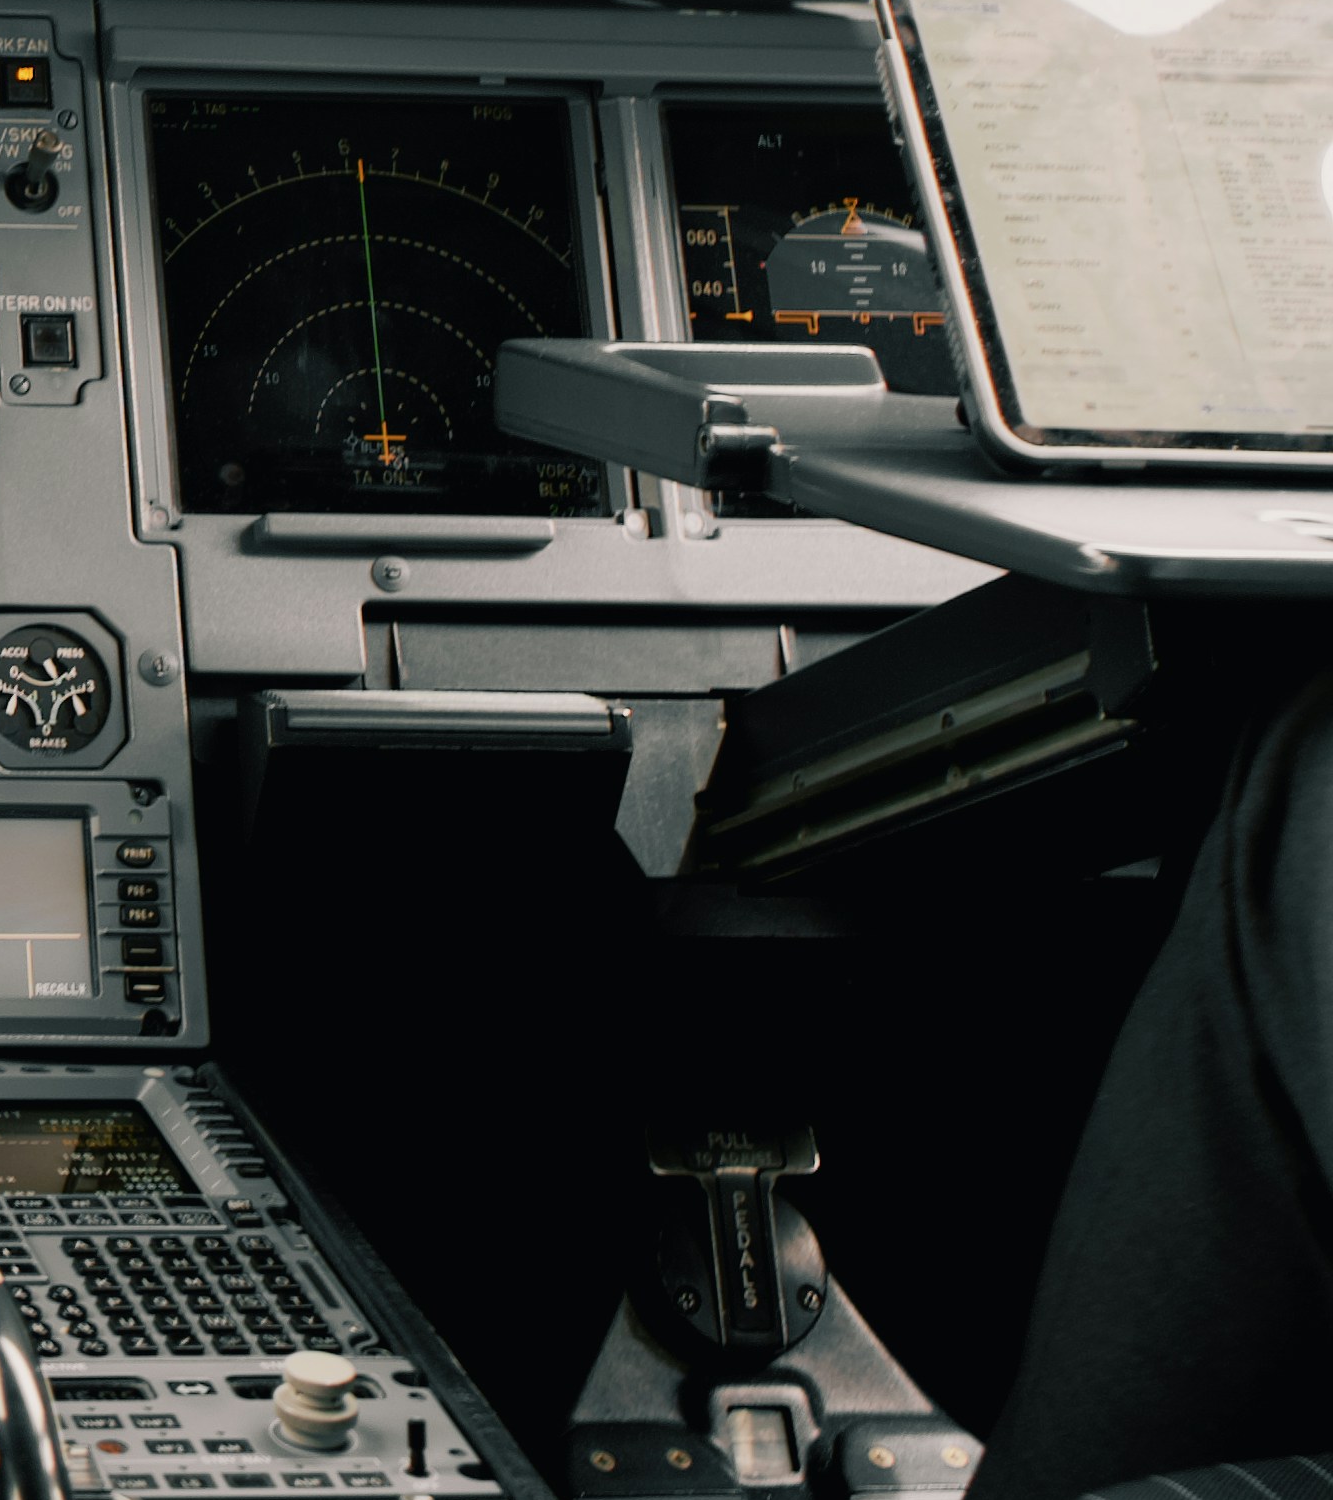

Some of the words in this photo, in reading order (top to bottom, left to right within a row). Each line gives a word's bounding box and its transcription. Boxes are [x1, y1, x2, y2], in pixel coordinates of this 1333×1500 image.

[18, 38, 48, 53] FAN
[58, 206, 81, 218] OFF
[44, 296, 67, 310] ON
[70, 296, 93, 311] ND
[124, 848, 152, 859] PRINT
